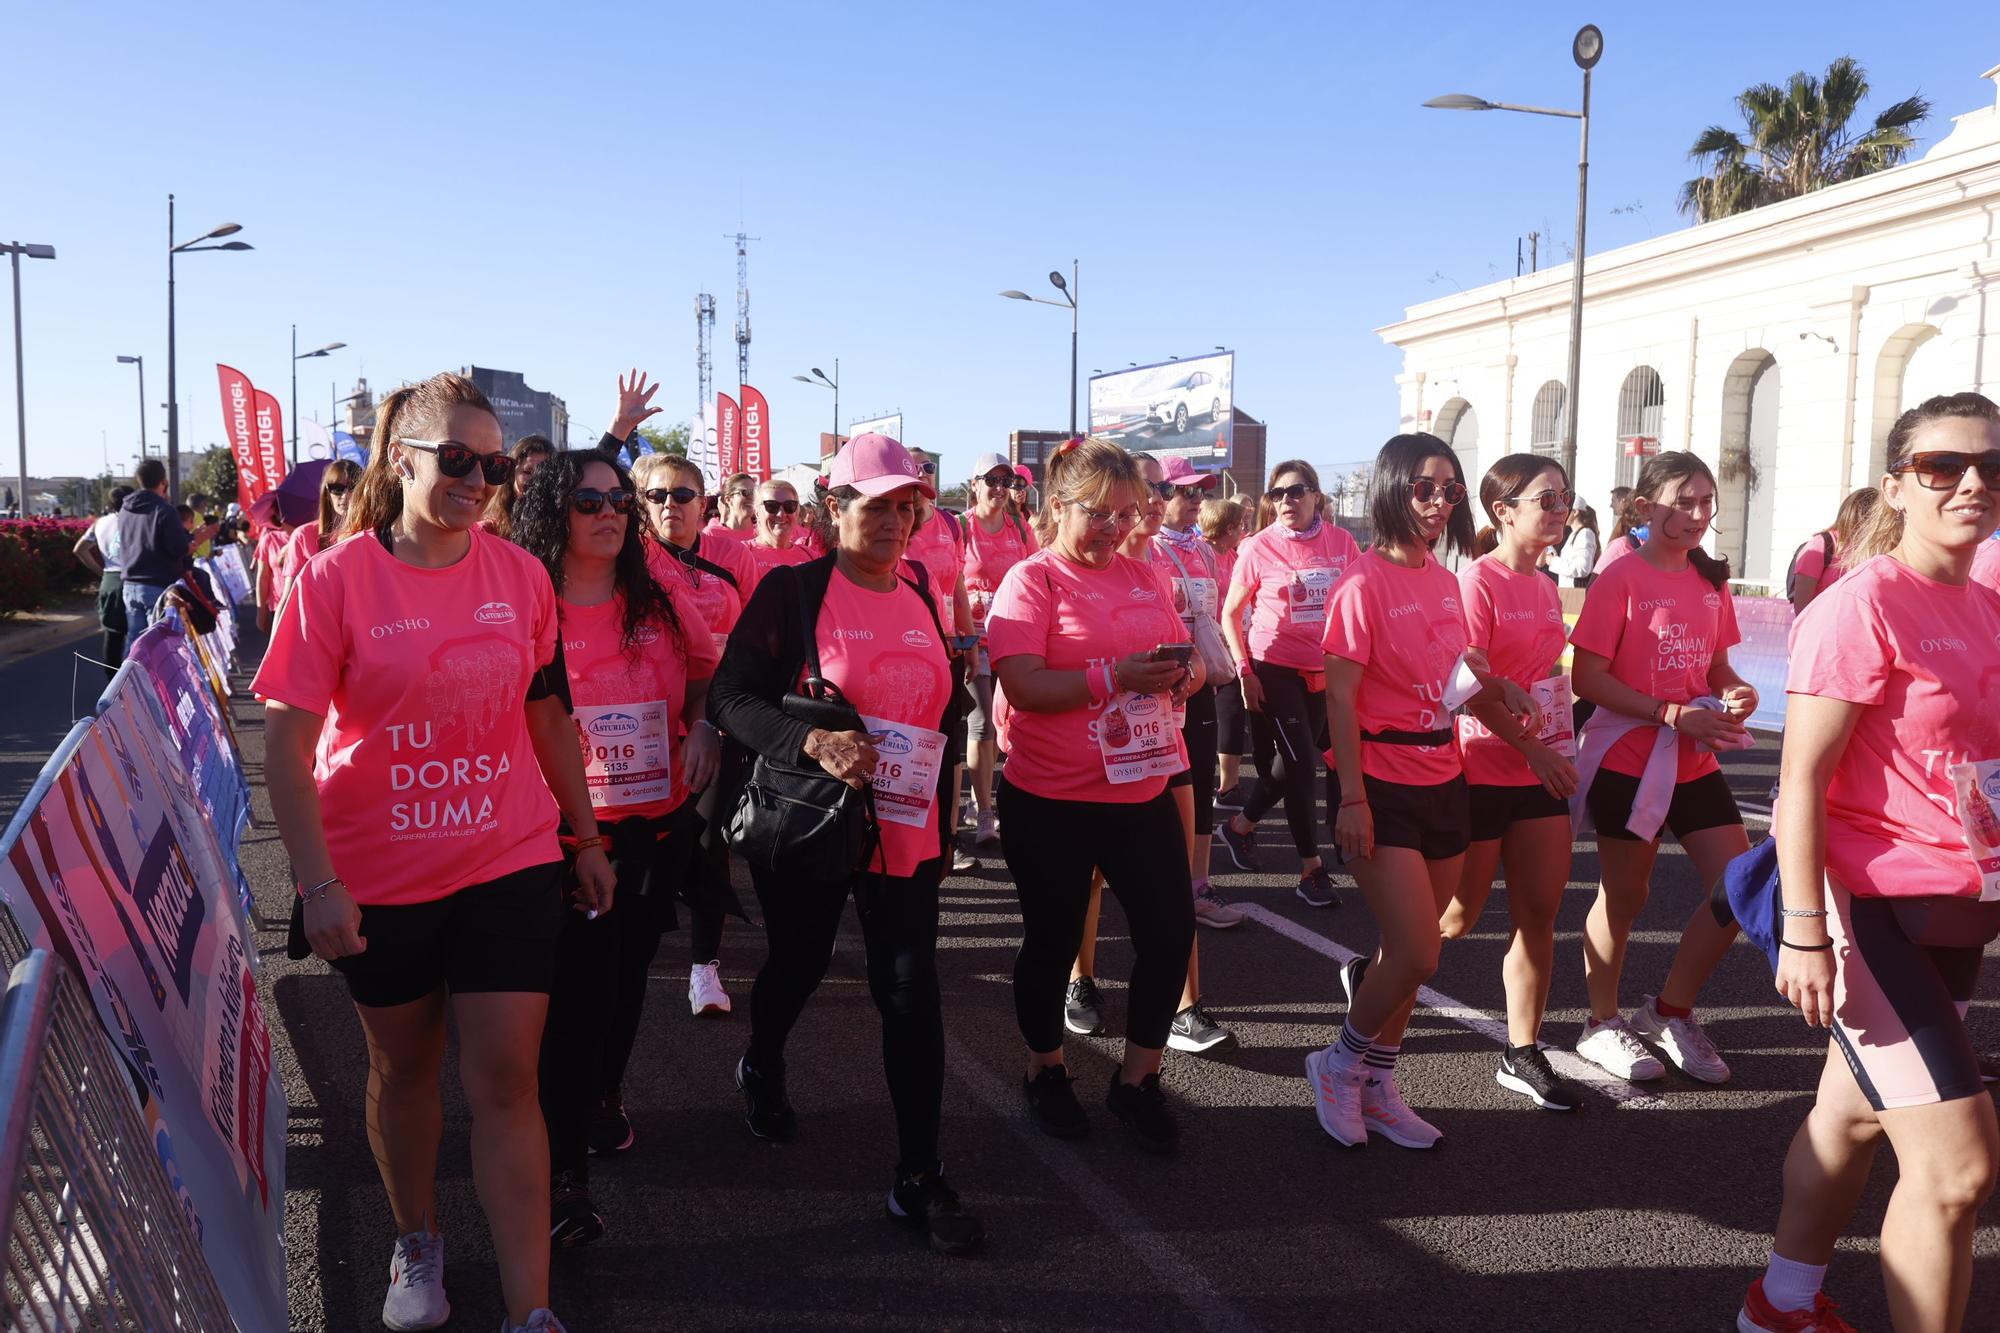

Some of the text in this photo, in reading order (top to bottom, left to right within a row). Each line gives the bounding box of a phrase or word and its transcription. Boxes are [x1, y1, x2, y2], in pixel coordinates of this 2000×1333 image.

[1308, 588, 1327, 597] 016
[1389, 602, 1422, 618] OYSHO
[1639, 598, 1676, 611] OYSHO
[1503, 609, 1534, 621] OYSHO
[371, 617, 430, 639] OYSHO
[833, 629, 873, 640] OYSHO
[1658, 623, 1688, 640] HOY
[1658, 638, 1705, 655] GANAN
[1920, 637, 1967, 653] OYSHO
[1658, 654, 1686, 671] LAS
[1412, 679, 1444, 702] TU
[593, 722, 635, 732] ASTURIANA
[1133, 721, 1159, 737] 016
[385, 721, 432, 751] TU
[1140, 738, 1157, 748] 3450
[596, 744, 635, 760] 016
[390, 751, 510, 790] DORSA
[604, 762, 628, 772] 5135
[631, 786, 663, 796] Santander
[390, 794, 493, 830] SUMA
[885, 806, 919, 817] Santander
[390, 832, 426, 841] CARRERA
[427, 831, 438, 839] DE
[450, 829, 476, 837] MUJER
